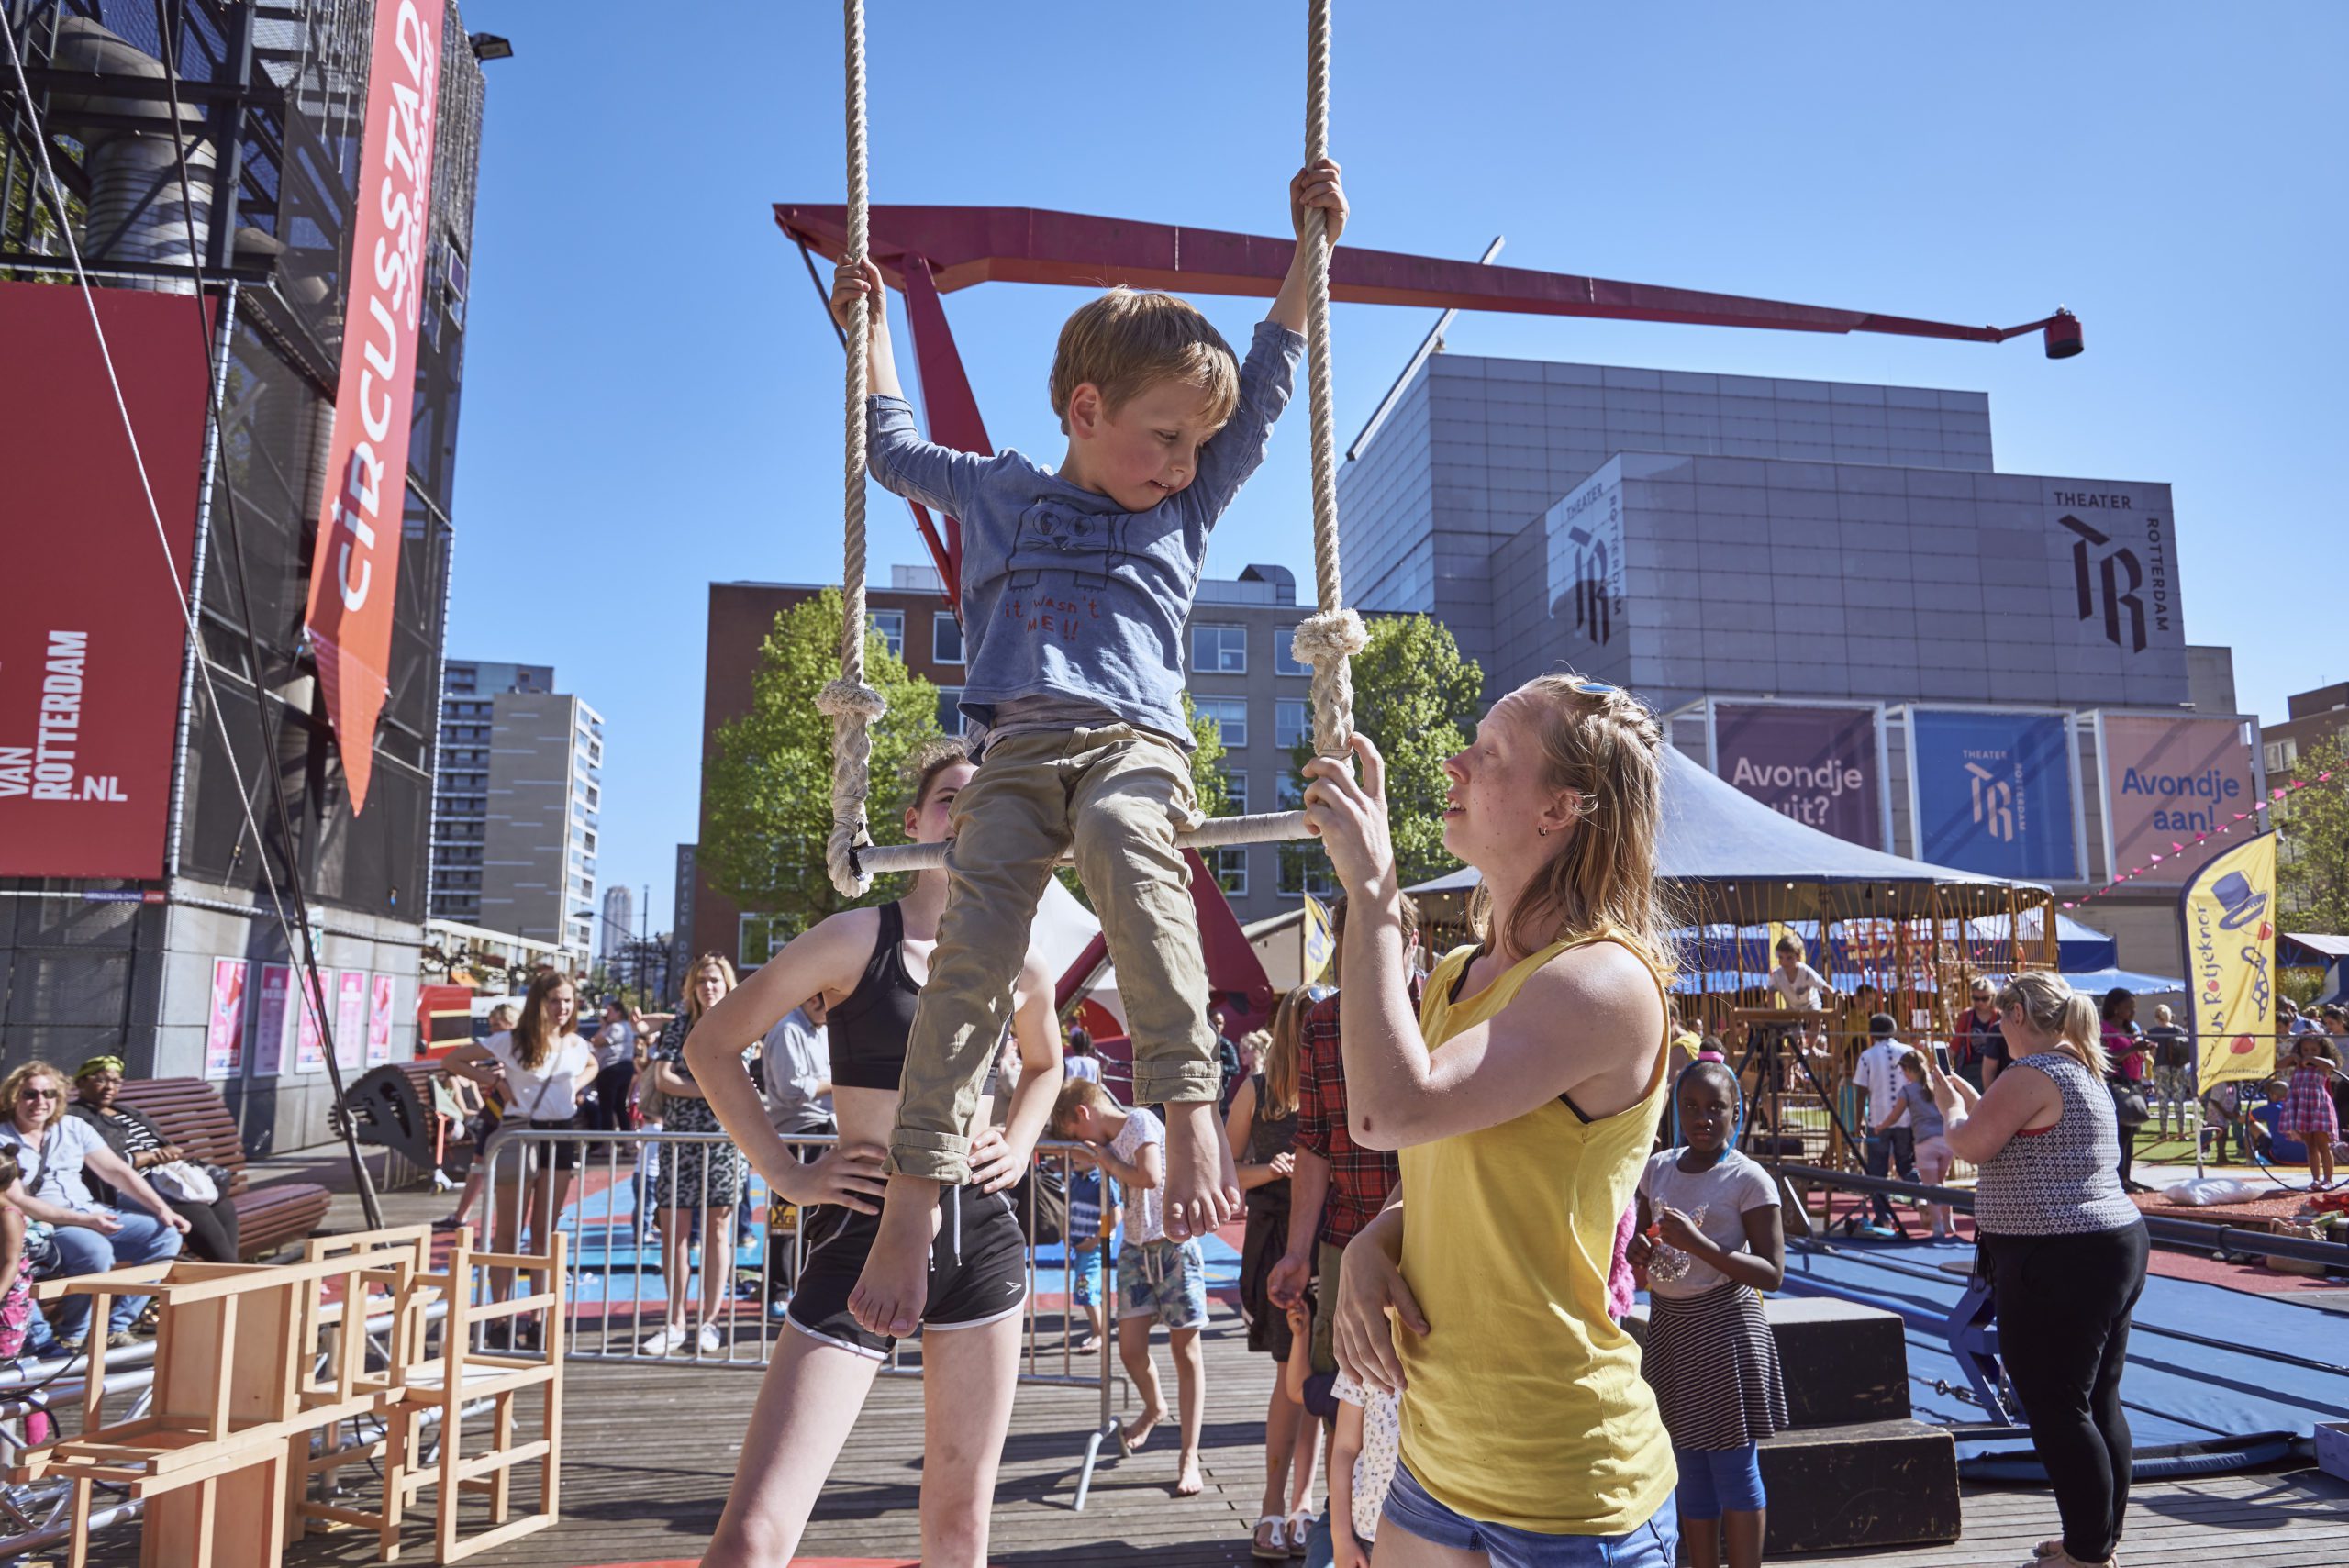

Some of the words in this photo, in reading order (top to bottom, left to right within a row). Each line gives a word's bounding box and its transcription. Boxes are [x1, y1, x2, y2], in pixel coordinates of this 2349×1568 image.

[1566, 483, 1604, 521] THEATER
[2054, 491, 2132, 510] THEATER
[1609, 495, 1622, 617] ROTTERDAM
[2146, 517, 2170, 632] ROTTERDAM
[1004, 601, 1025, 619] it
[1033, 595, 1101, 620] wasn't
[32, 629, 88, 801] ROTTERDAM
[0, 747, 34, 797] VAN
[1962, 750, 2007, 761] THEATER
[1731, 757, 1864, 797] Avondje
[2121, 767, 2240, 805] Avondje
[2153, 806, 2215, 832] aan!
[680, 851, 693, 926] OFFICE
